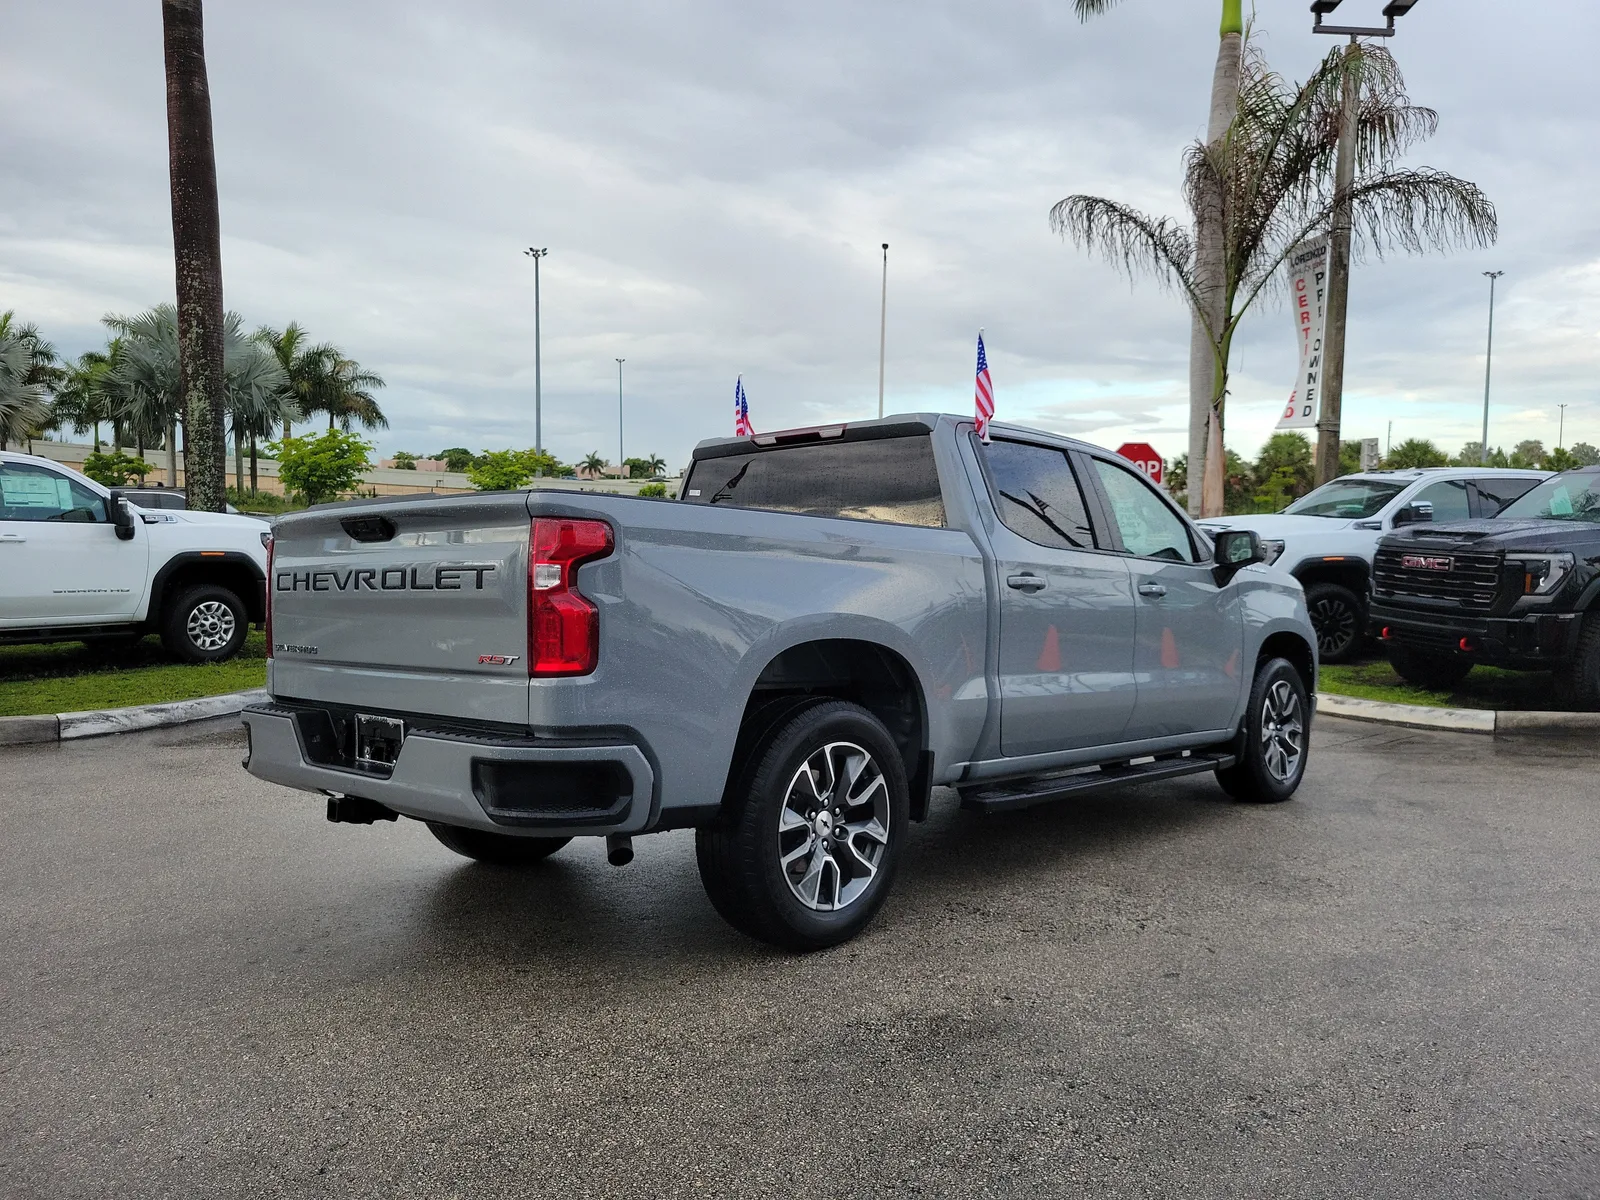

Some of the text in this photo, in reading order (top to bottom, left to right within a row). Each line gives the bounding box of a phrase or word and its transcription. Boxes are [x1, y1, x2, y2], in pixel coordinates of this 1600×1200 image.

[1284, 279, 1311, 418] CERTIED
[1133, 460, 1160, 478] OP
[1402, 556, 1450, 571] GMC
[276, 564, 495, 592] CHEVROLET
[478, 655, 520, 665] RST
